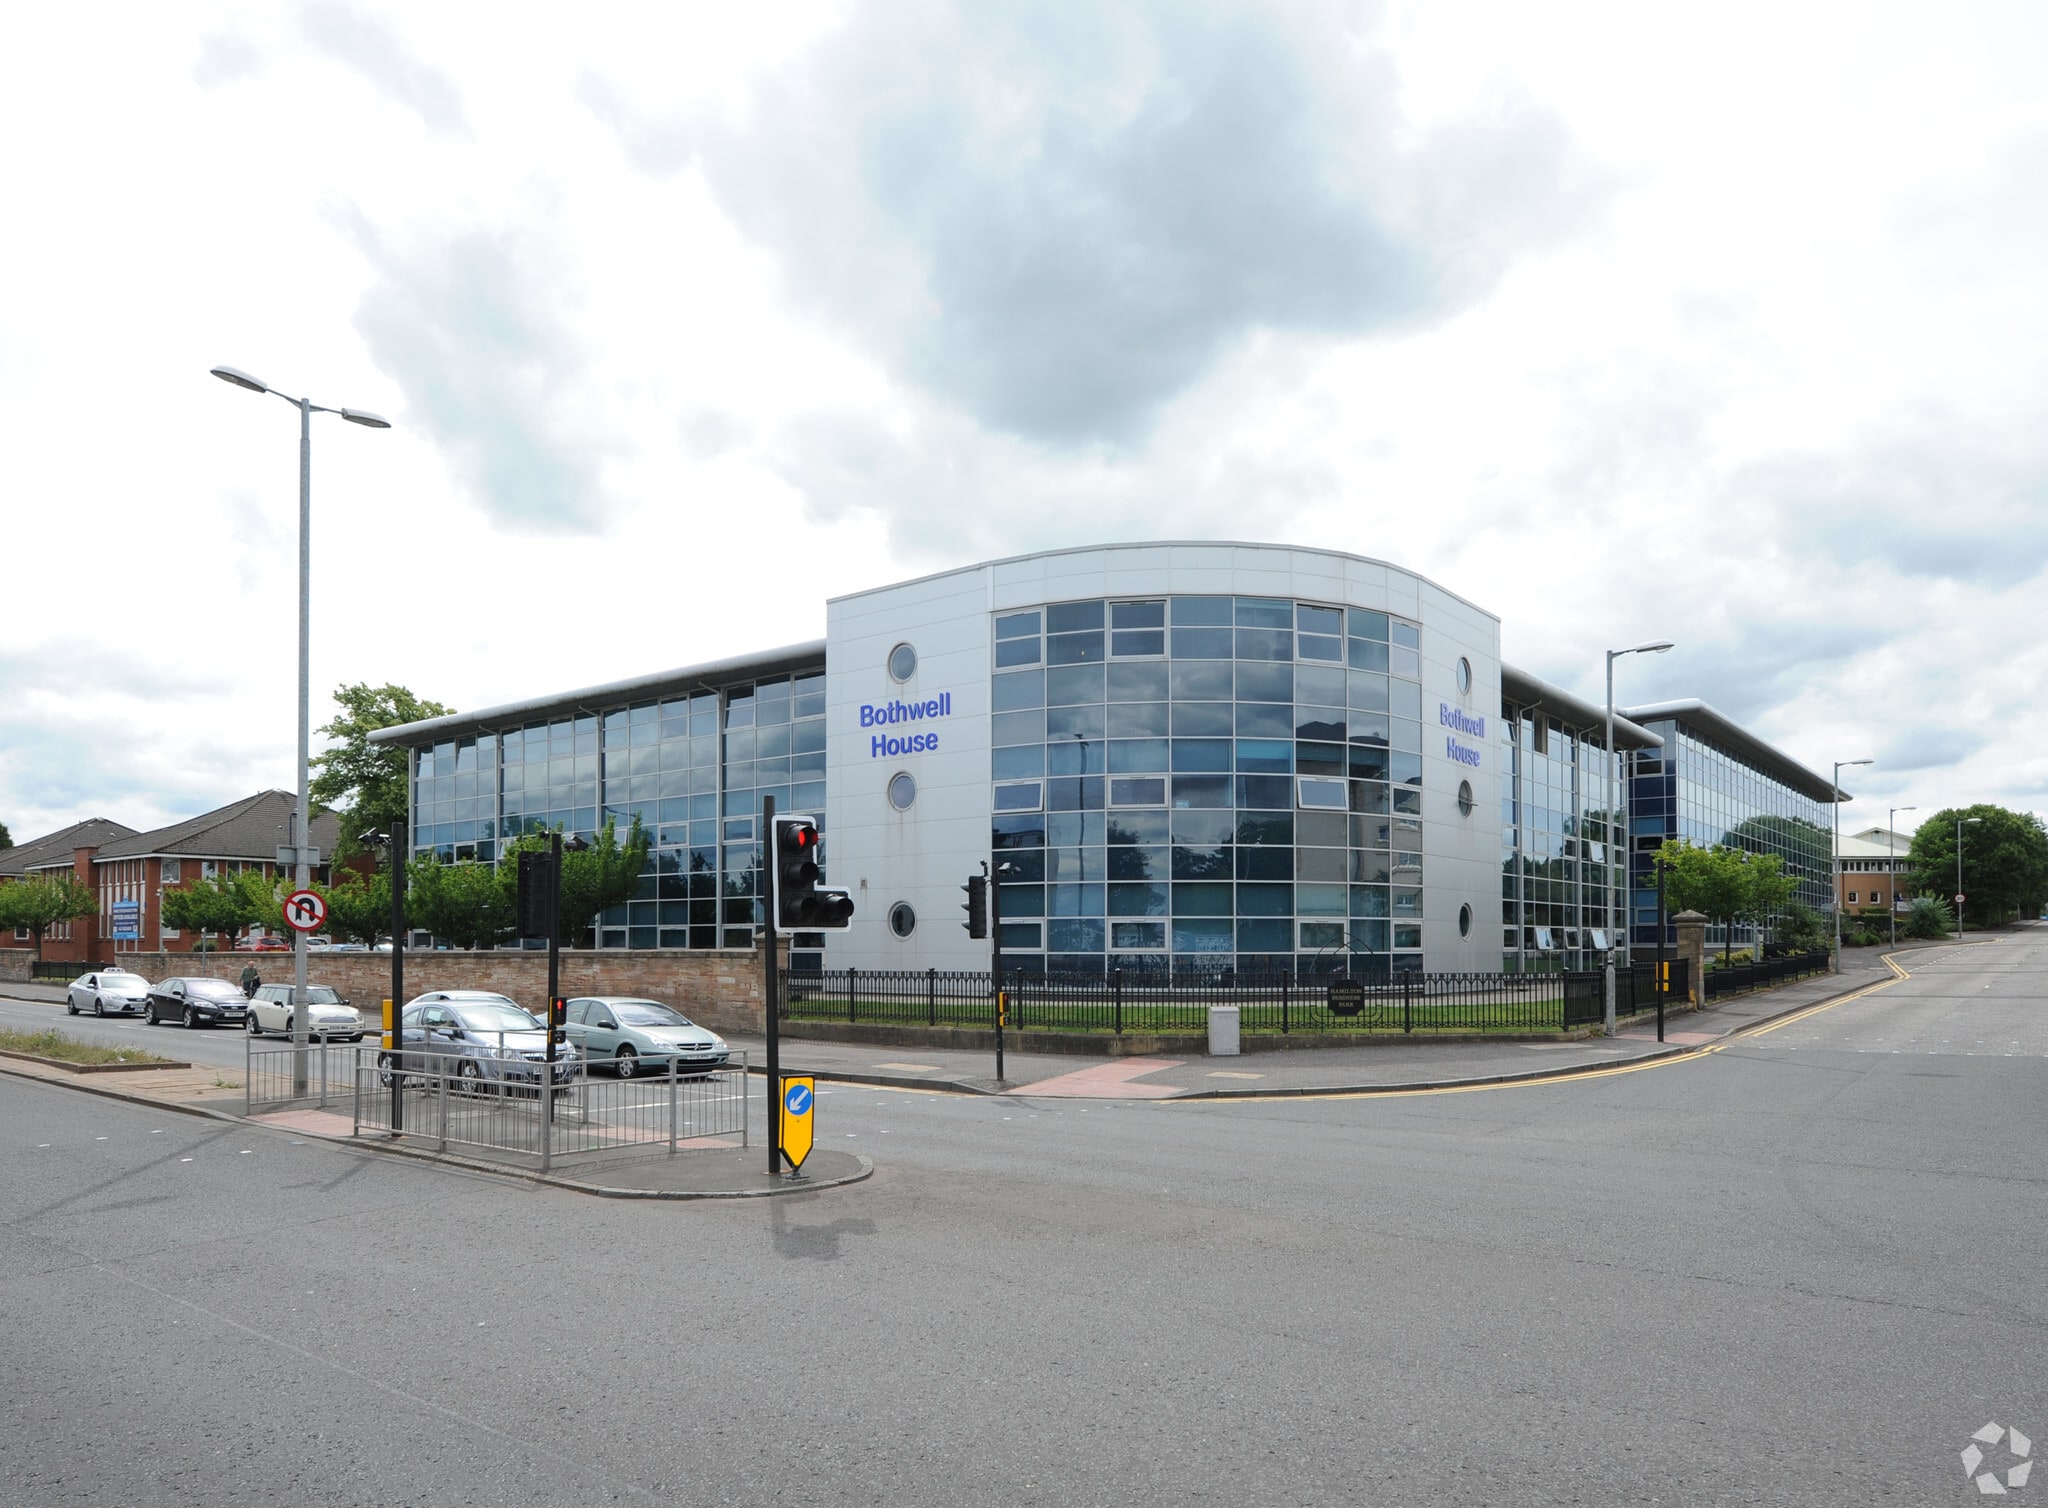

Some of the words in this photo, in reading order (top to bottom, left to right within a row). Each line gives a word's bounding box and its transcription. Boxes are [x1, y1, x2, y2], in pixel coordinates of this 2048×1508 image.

[860, 692, 951, 728] Bothwell
[1440, 702, 1485, 738] Bothwell
[872, 733, 938, 758] House
[1446, 736, 1480, 767] House
